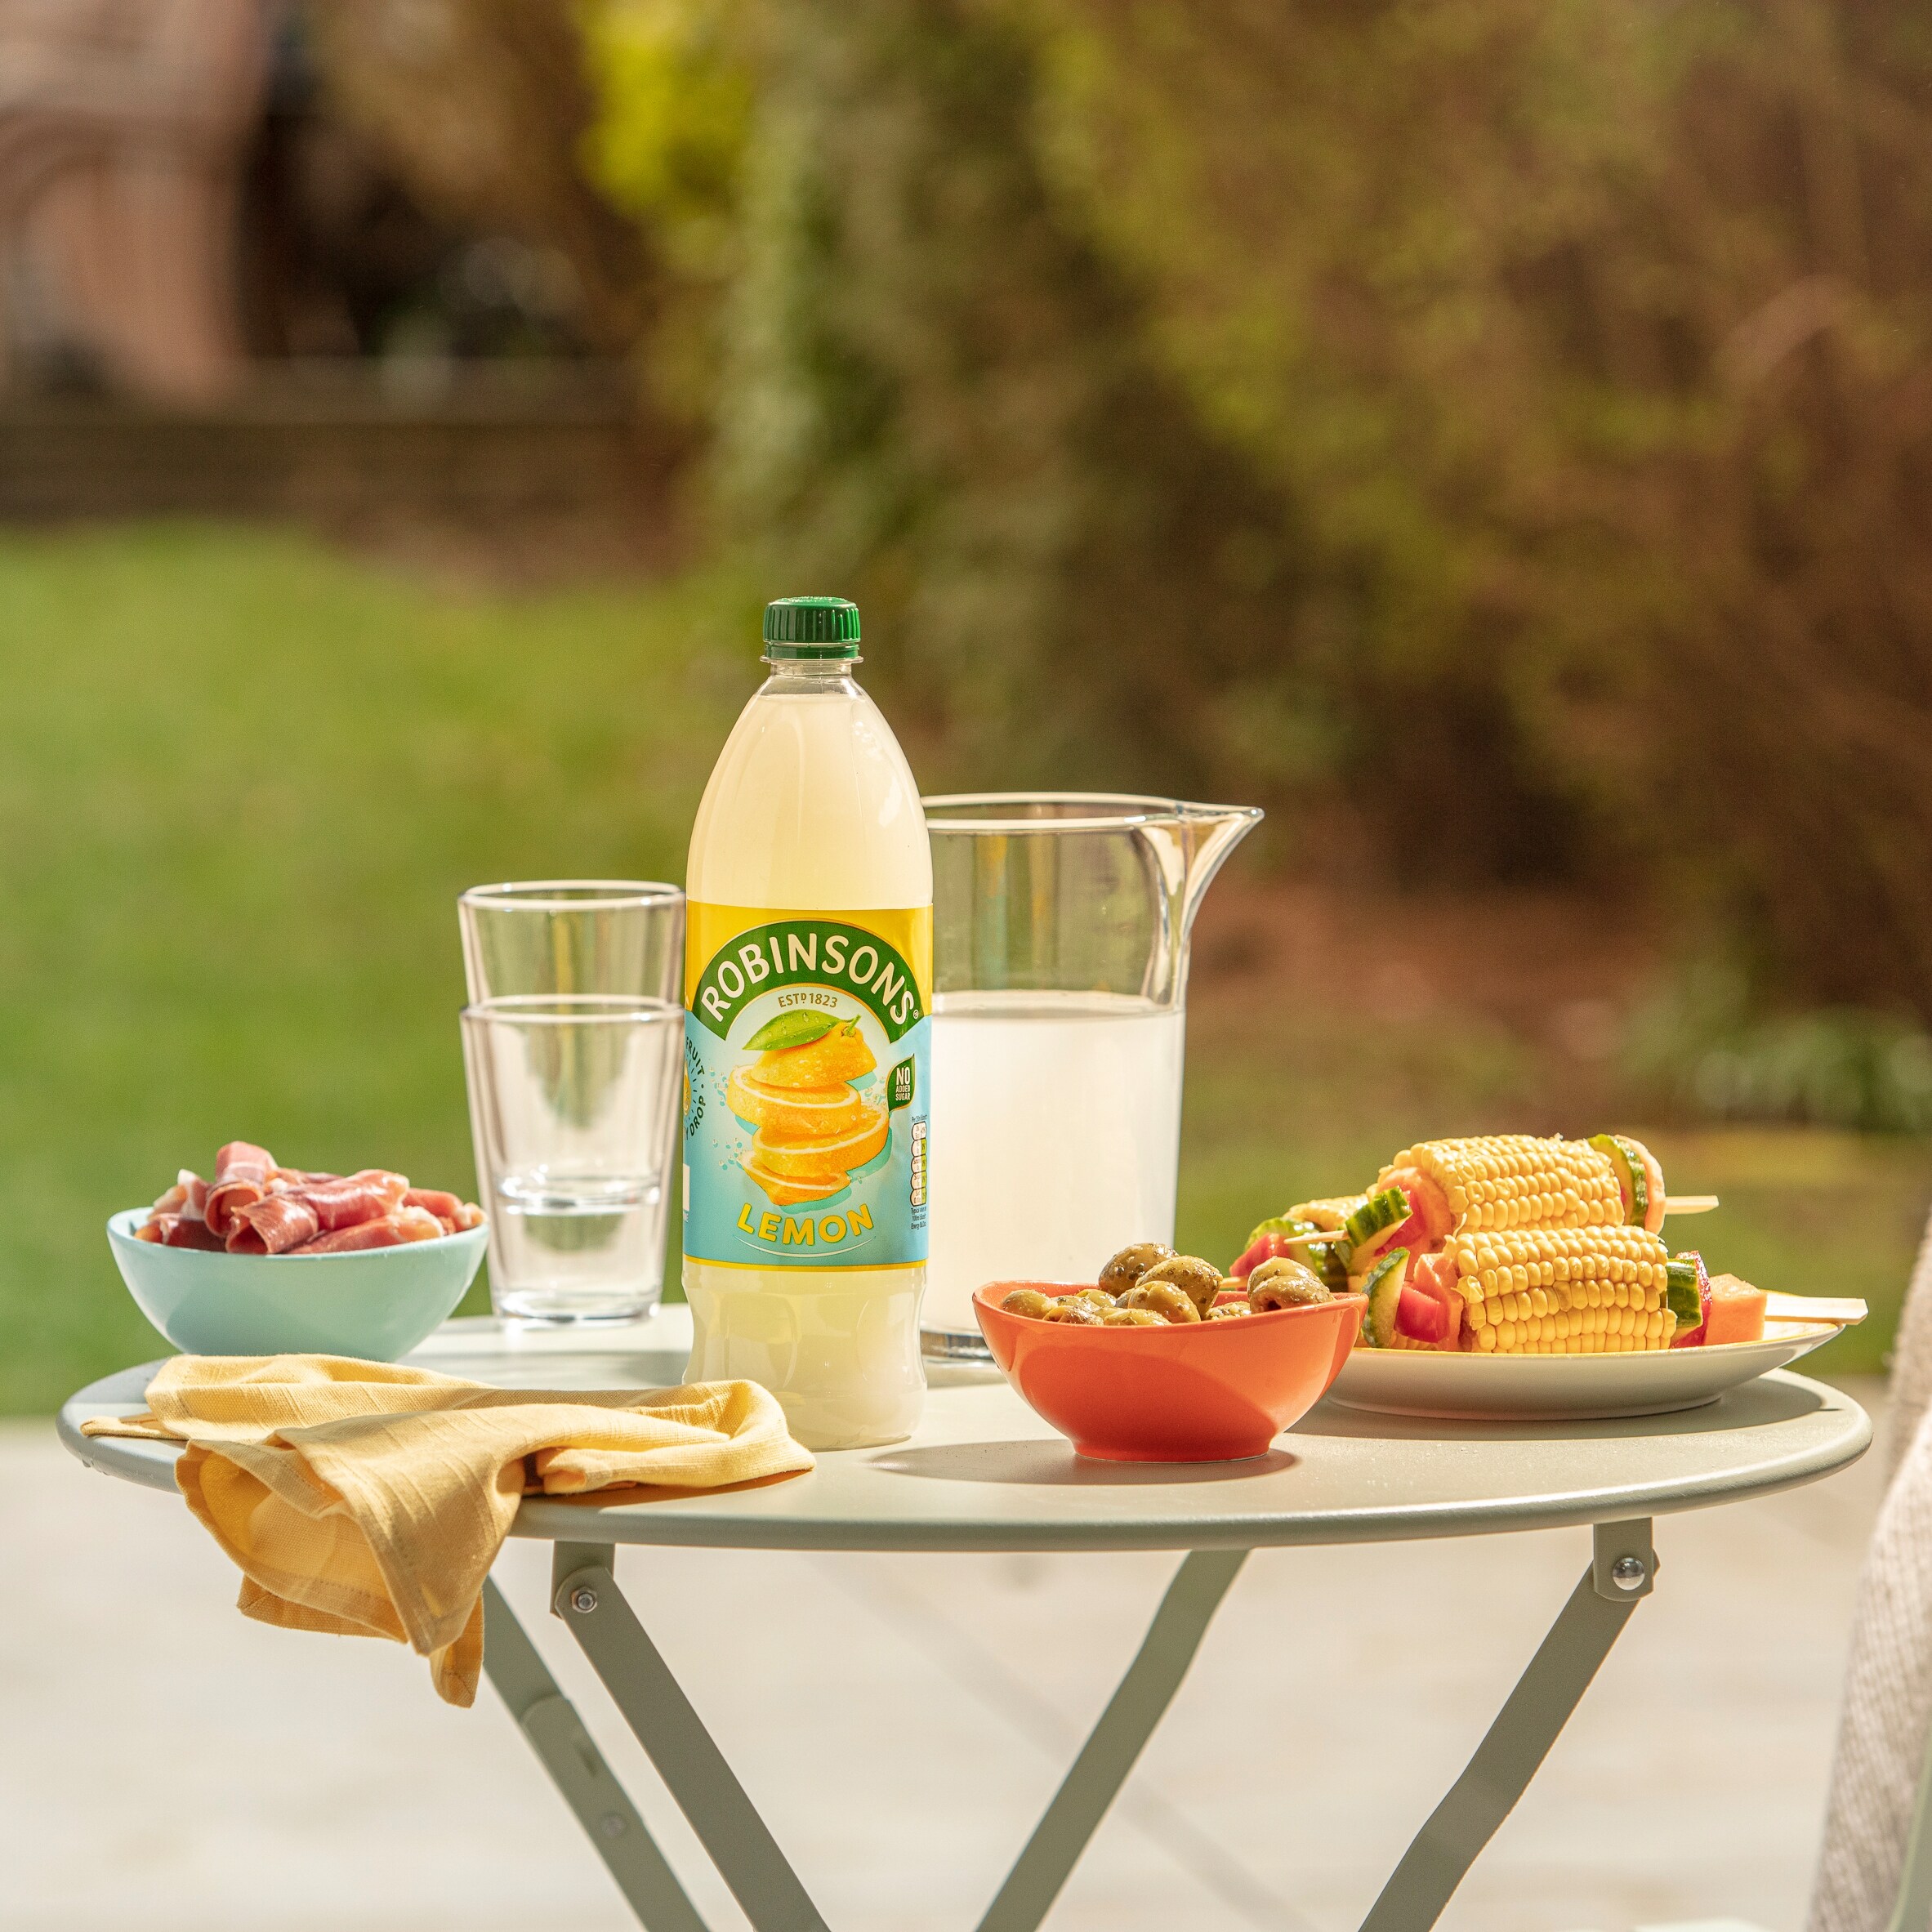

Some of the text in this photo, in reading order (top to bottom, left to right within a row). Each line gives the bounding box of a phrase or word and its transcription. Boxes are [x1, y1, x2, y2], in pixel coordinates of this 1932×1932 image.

[701, 933, 915, 1025] ROBINSONS
[809, 993, 838, 1008] 1823
[685, 1036, 705, 1075] FRUIT
[895, 1085, 911, 1093] ADDED
[896, 1066, 911, 1085] NO
[895, 1092, 911, 1101] SUGAR
[689, 1095, 706, 1136] DROP
[736, 1202, 874, 1246] LEMON
